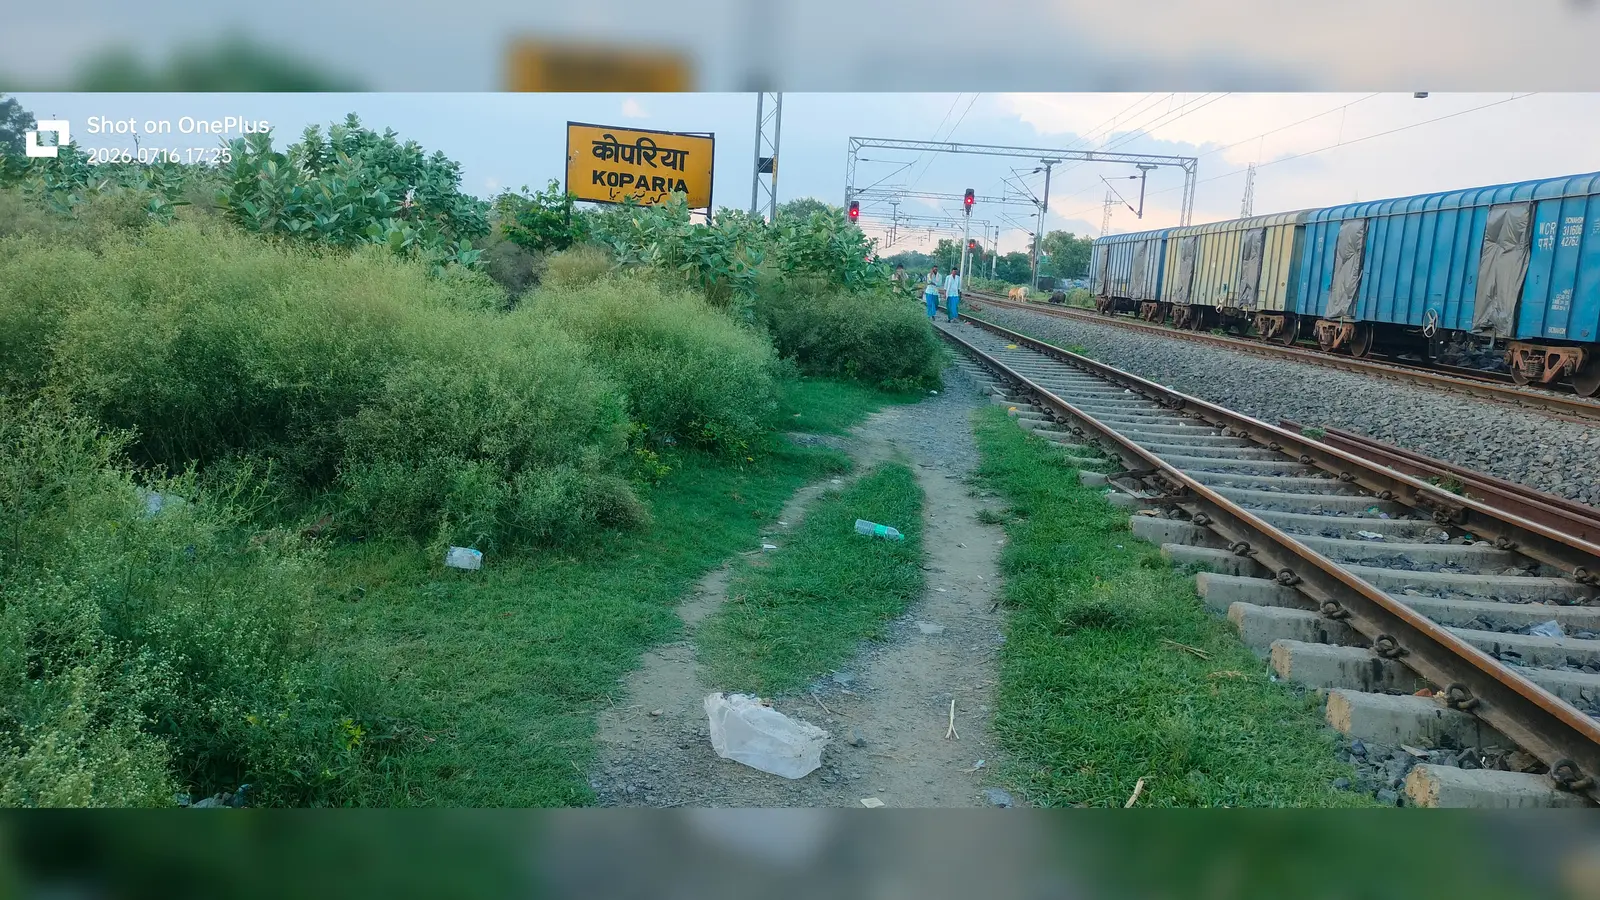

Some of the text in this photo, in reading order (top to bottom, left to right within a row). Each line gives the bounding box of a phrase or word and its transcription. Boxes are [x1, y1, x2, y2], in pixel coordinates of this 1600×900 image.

[592, 134, 689, 172] कोपरिया
[592, 170, 689, 194] KOPARIA
[1539, 222, 1557, 235] WCR
